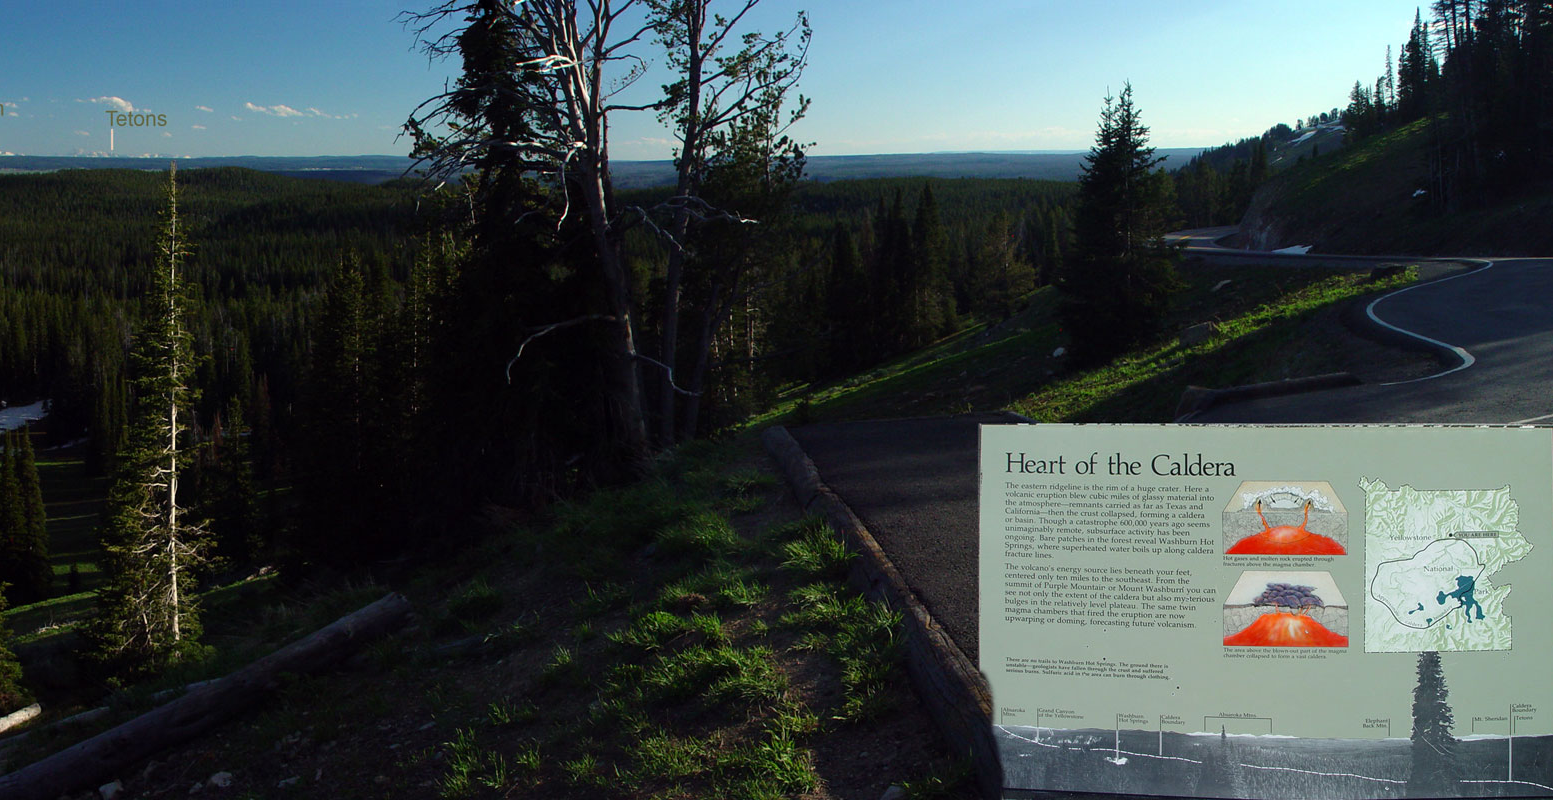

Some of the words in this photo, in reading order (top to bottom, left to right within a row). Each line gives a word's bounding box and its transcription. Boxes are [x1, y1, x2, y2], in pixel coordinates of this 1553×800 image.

[1005, 452, 1066, 474] Heart
[1075, 452, 1098, 475] of
[1108, 453, 1141, 476] the
[1151, 454, 1236, 477] Caldera
[1049, 482, 1082, 492] ridgeline
[1137, 483, 1156, 494] huge
[1184, 484, 1203, 492] Here
[1005, 490, 1034, 498] volcanic
[1036, 492, 1068, 500] eruption
[1141, 492, 1165, 502] glassy
[1018, 499, 1104, 509] atmosphere—remnants
[1167, 501, 1187, 509] Texas
[1005, 507, 1064, 516] California—then
[1100, 509, 1138, 519] collapsed,
[1139, 510, 1170, 520] forming
[1178, 510, 1205, 518] caldera
[1014, 516, 1035, 524] basin.
[1040, 516, 1067, 526] Though
[1075, 518, 1118, 528] catastrophe
[1119, 518, 1148, 527] 600,000
[1005, 525, 1054, 535] unimaginably
[1056, 526, 1085, 535] remote,
[1086, 526, 1126, 534] subsurface
[1127, 528, 1155, 537] activity
[1172, 528, 1190, 536] been
[1004, 534, 1037, 543] ongoing.
[1057, 534, 1085, 544] patches
[1111, 535, 1132, 543] forest
[1159, 536, 1198, 545] Washburn
[1004, 541, 1035, 552] Springs,
[1037, 542, 1060, 550] where
[1062, 543, 1107, 553] superheated
[1132, 545, 1150, 553] boils
[1164, 546, 1185, 556] along
[1186, 546, 1214, 554] caldera
[1004, 550, 1033, 558] fracture
[1034, 551, 1055, 559] lines.
[1005, 562, 1019, 570] The
[1021, 563, 1055, 571] volcano's
[1109, 566, 1122, 574] lies
[1124, 566, 1154, 574] beneath
[1176, 568, 1193, 577] feet,
[1037, 572, 1054, 582] only
[1115, 575, 1154, 583] southeast.
[1155, 575, 1175, 583] From
[1044, 580, 1068, 591] Purple
[1070, 581, 1106, 590] Mountain
[1118, 583, 1143, 591] Mount
[1145, 584, 1184, 592] Washburn
